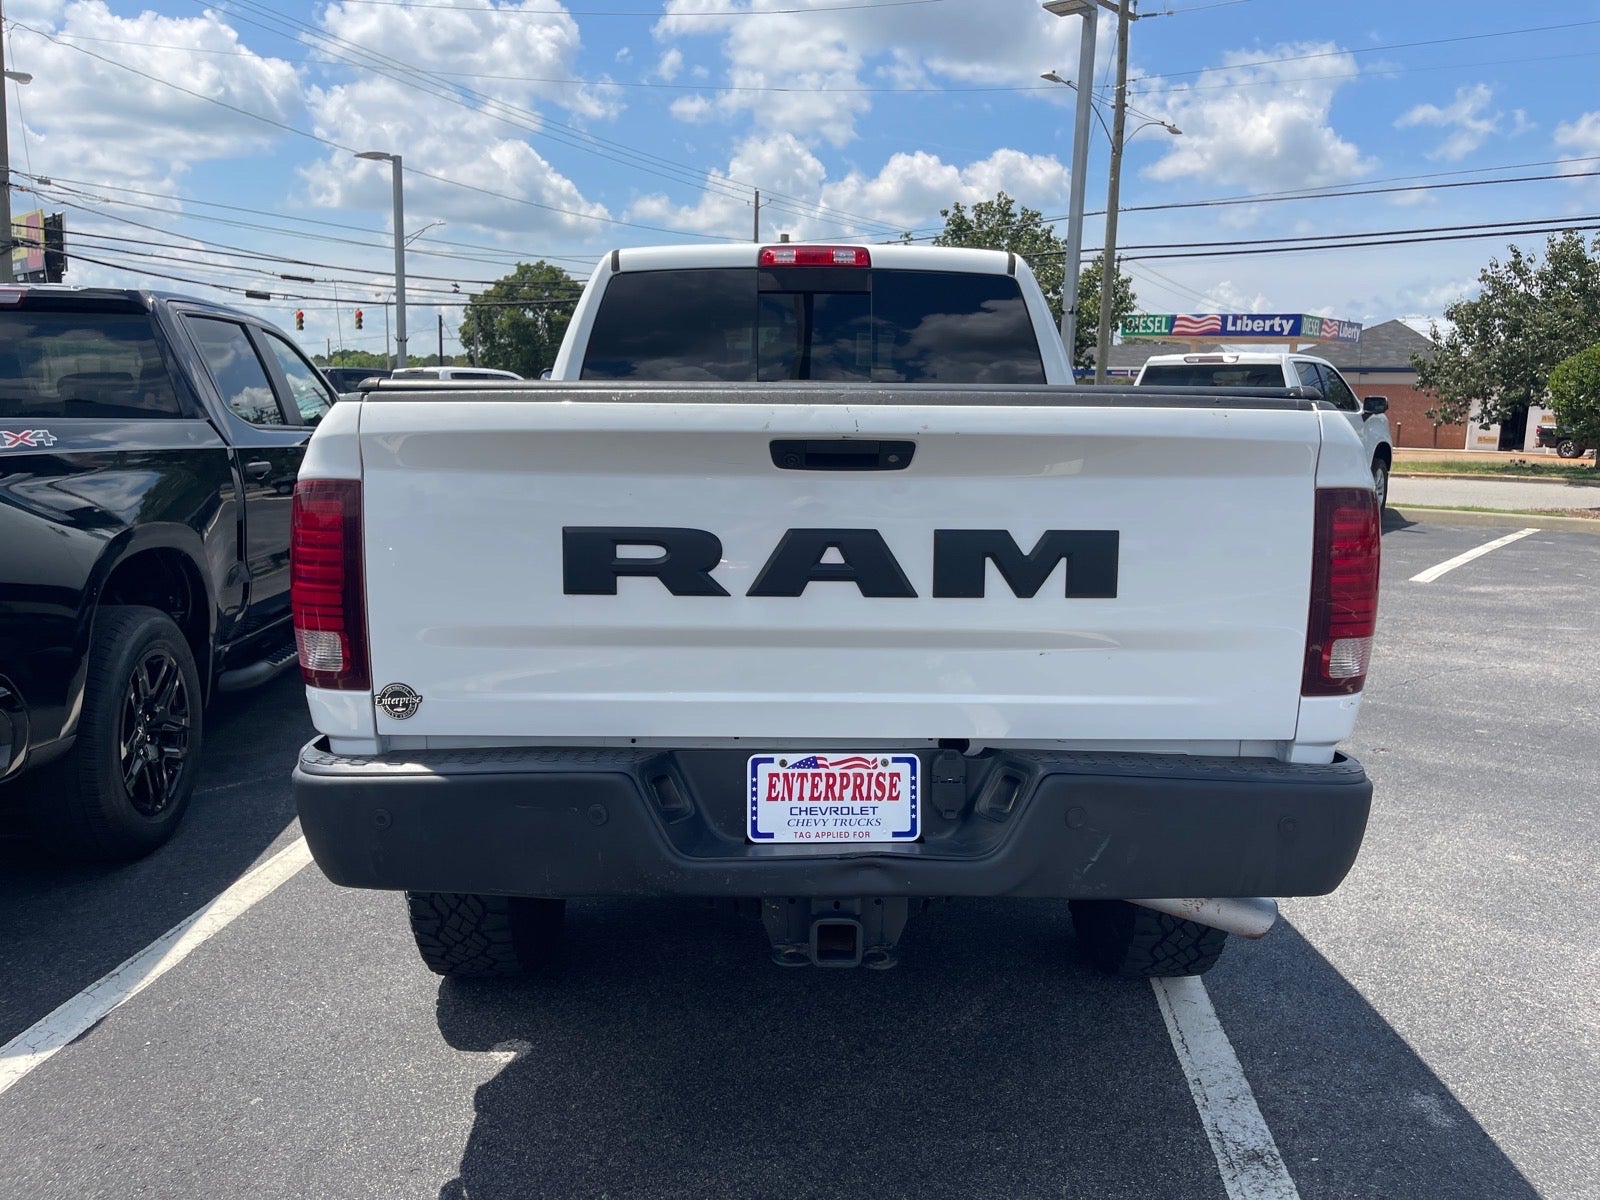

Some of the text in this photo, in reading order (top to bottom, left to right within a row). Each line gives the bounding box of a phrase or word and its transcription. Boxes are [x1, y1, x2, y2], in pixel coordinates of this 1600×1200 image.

[1226, 315, 1295, 336] Liberty
[1302, 317, 1320, 336] DIESEL
[1339, 322, 1361, 343] Liberty
[562, 526, 1120, 598] RAM
[374, 695, 422, 707] Enterprise
[766, 772, 901, 802] ENTERPRISE
[789, 806, 879, 816] CHEVROLET
[787, 817, 882, 827] CHEVY TRUCKS
[793, 831, 812, 839] TAG
[815, 831, 850, 839] APPLIED
